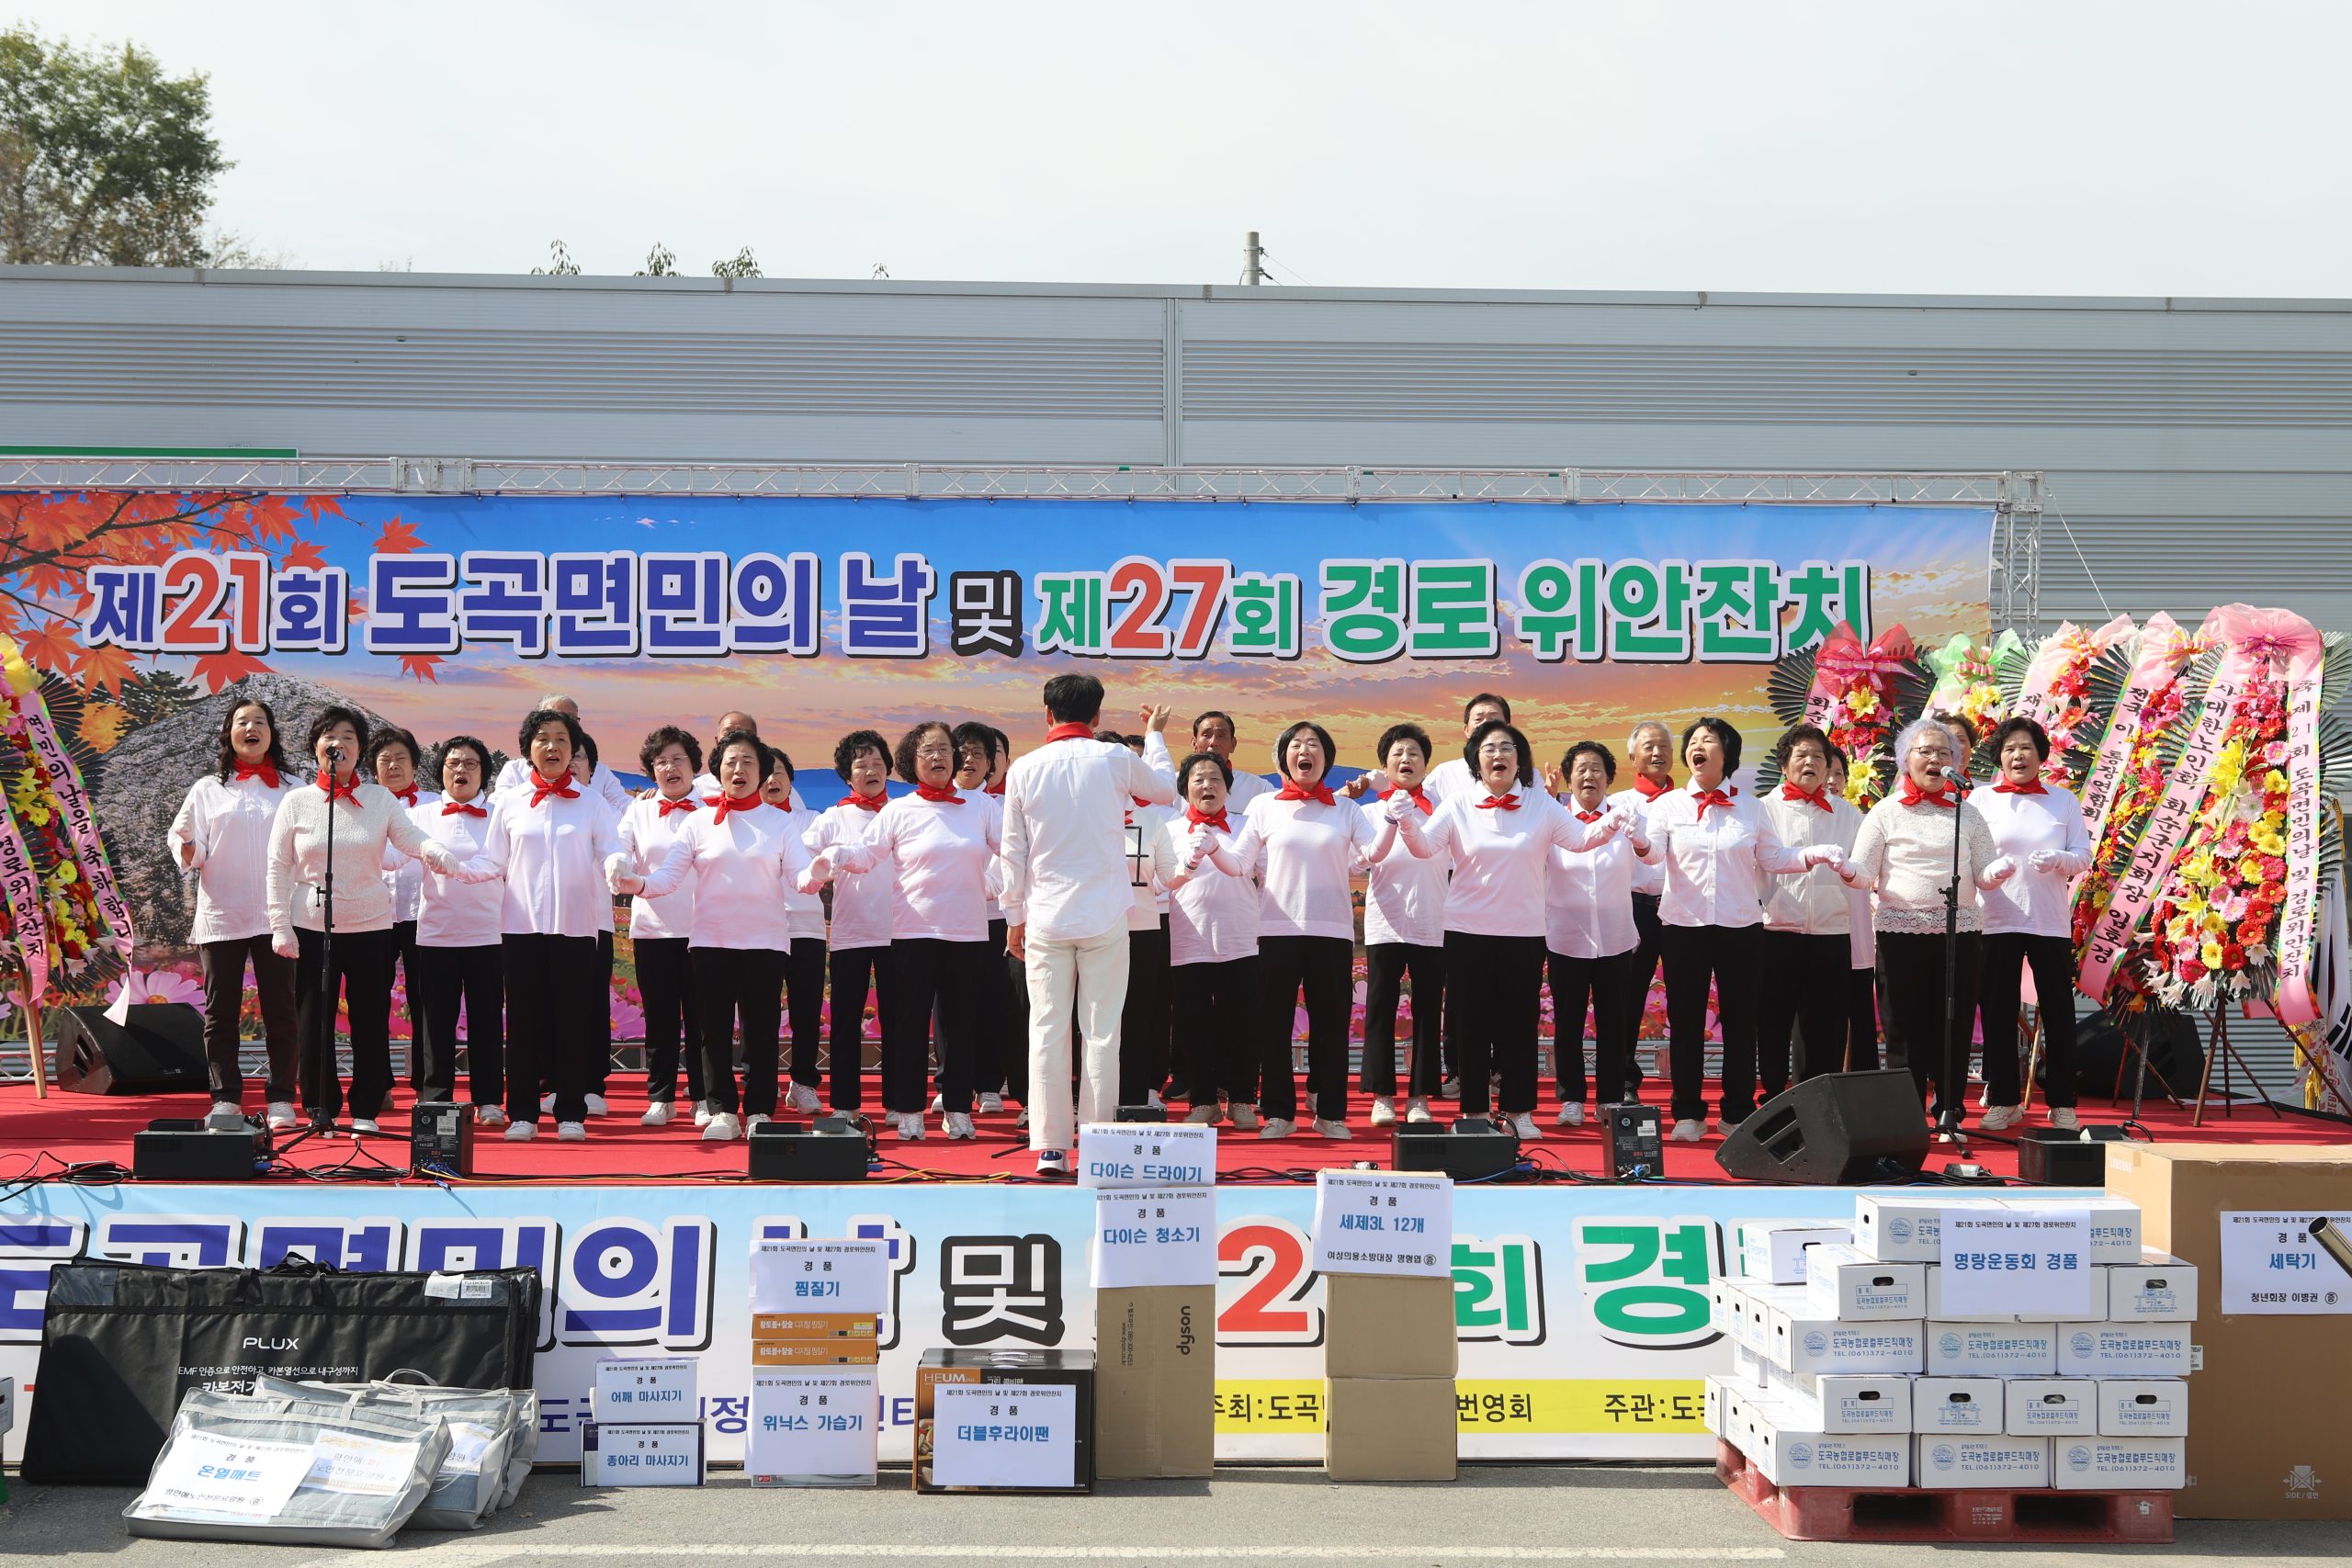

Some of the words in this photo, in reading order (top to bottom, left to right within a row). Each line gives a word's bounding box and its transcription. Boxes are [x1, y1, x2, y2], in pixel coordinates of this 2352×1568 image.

[92, 557, 338, 645] 제21회
[370, 557, 811, 648] 도곡면민의
[846, 558, 927, 649] 날
[956, 576, 1014, 647] 및
[1039, 562, 1292, 649] 제27회
[1326, 565, 1491, 653] 경로
[1521, 565, 1862, 654] 위안잔치
[1091, 1163, 1134, 1179] 다이슨
[1142, 1165, 1202, 1182] 드라이기
[1340, 1214, 1385, 1231] 세제3L
[1394, 1217, 1424, 1233] 12개
[1103, 1228, 1148, 1245] 다이슨
[1156, 1227, 1199, 1244] 청소기
[1328, 1251, 1393, 1262] 여성의용소방대장
[1954, 1253, 2036, 1270] 명랑운동회
[2046, 1253, 2078, 1270] 경품
[2269, 1253, 2315, 1269] 세탁기
[795, 1281, 840, 1297] 찜질기
[950, 1241, 1046, 1333] 및
[2251, 1292, 2287, 1303] 청년회장
[2291, 1292, 2318, 1303] 이병권
[1176, 1305, 1195, 1355] dyson
[243, 1337, 300, 1349] PLUX
[1834, 1337, 1913, 1348] 도곡농협로컬푸드직매장
[1969, 1340, 2047, 1350] 도곡농협로컬푸드직매장
[2100, 1340, 2181, 1350] 도곡농협로컬푸드직매장
[178, 1366, 198, 1375] EMF
[199, 1366, 231, 1376] 인증으로
[232, 1365, 265, 1376] 안전하고
[318, 1366, 358, 1376] 내구성까지
[611, 1392, 632, 1403] 어깨
[639, 1390, 682, 1403] 마사지기
[763, 1416, 808, 1431] 위닉스
[818, 1415, 862, 1431] 가습기
[957, 1426, 1049, 1442] 더블후라이팬
[607, 1455, 639, 1467] 종아리
[646, 1455, 688, 1466] 마사지기
[1818, 1451, 1899, 1461] 도곡농협로컬푸드직매장
[1962, 1451, 2040, 1461] 도곡농협로컬푸드직매장
[2097, 1453, 2176, 1462] 도곡농협로컬푸드직매장
